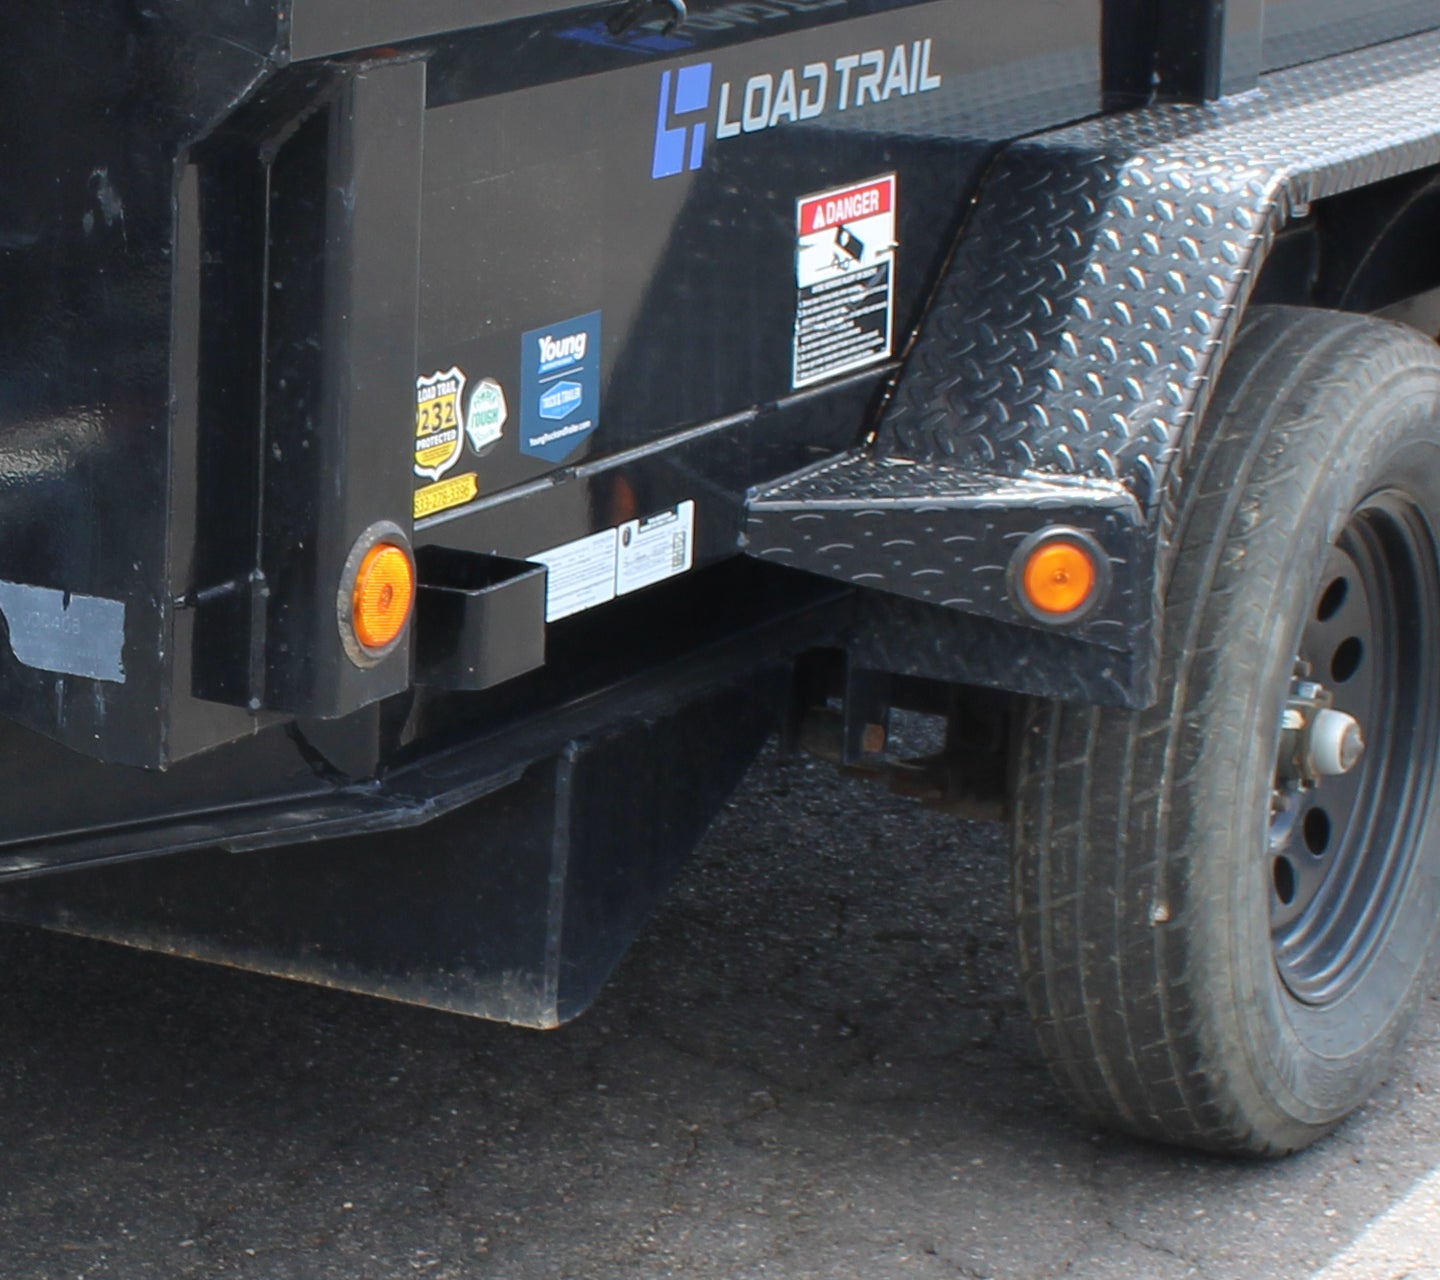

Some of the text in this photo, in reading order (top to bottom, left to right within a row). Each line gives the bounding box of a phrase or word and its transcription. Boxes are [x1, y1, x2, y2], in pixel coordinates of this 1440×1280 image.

[716, 38, 942, 140] LOAD TRAIL
[826, 188, 880, 222] DANGER
[538, 332, 588, 365] Young
[417, 379, 457, 403] LOAD TRAIL
[421, 402, 454, 433] 232
[416, 429, 457, 451] PROTECTED
